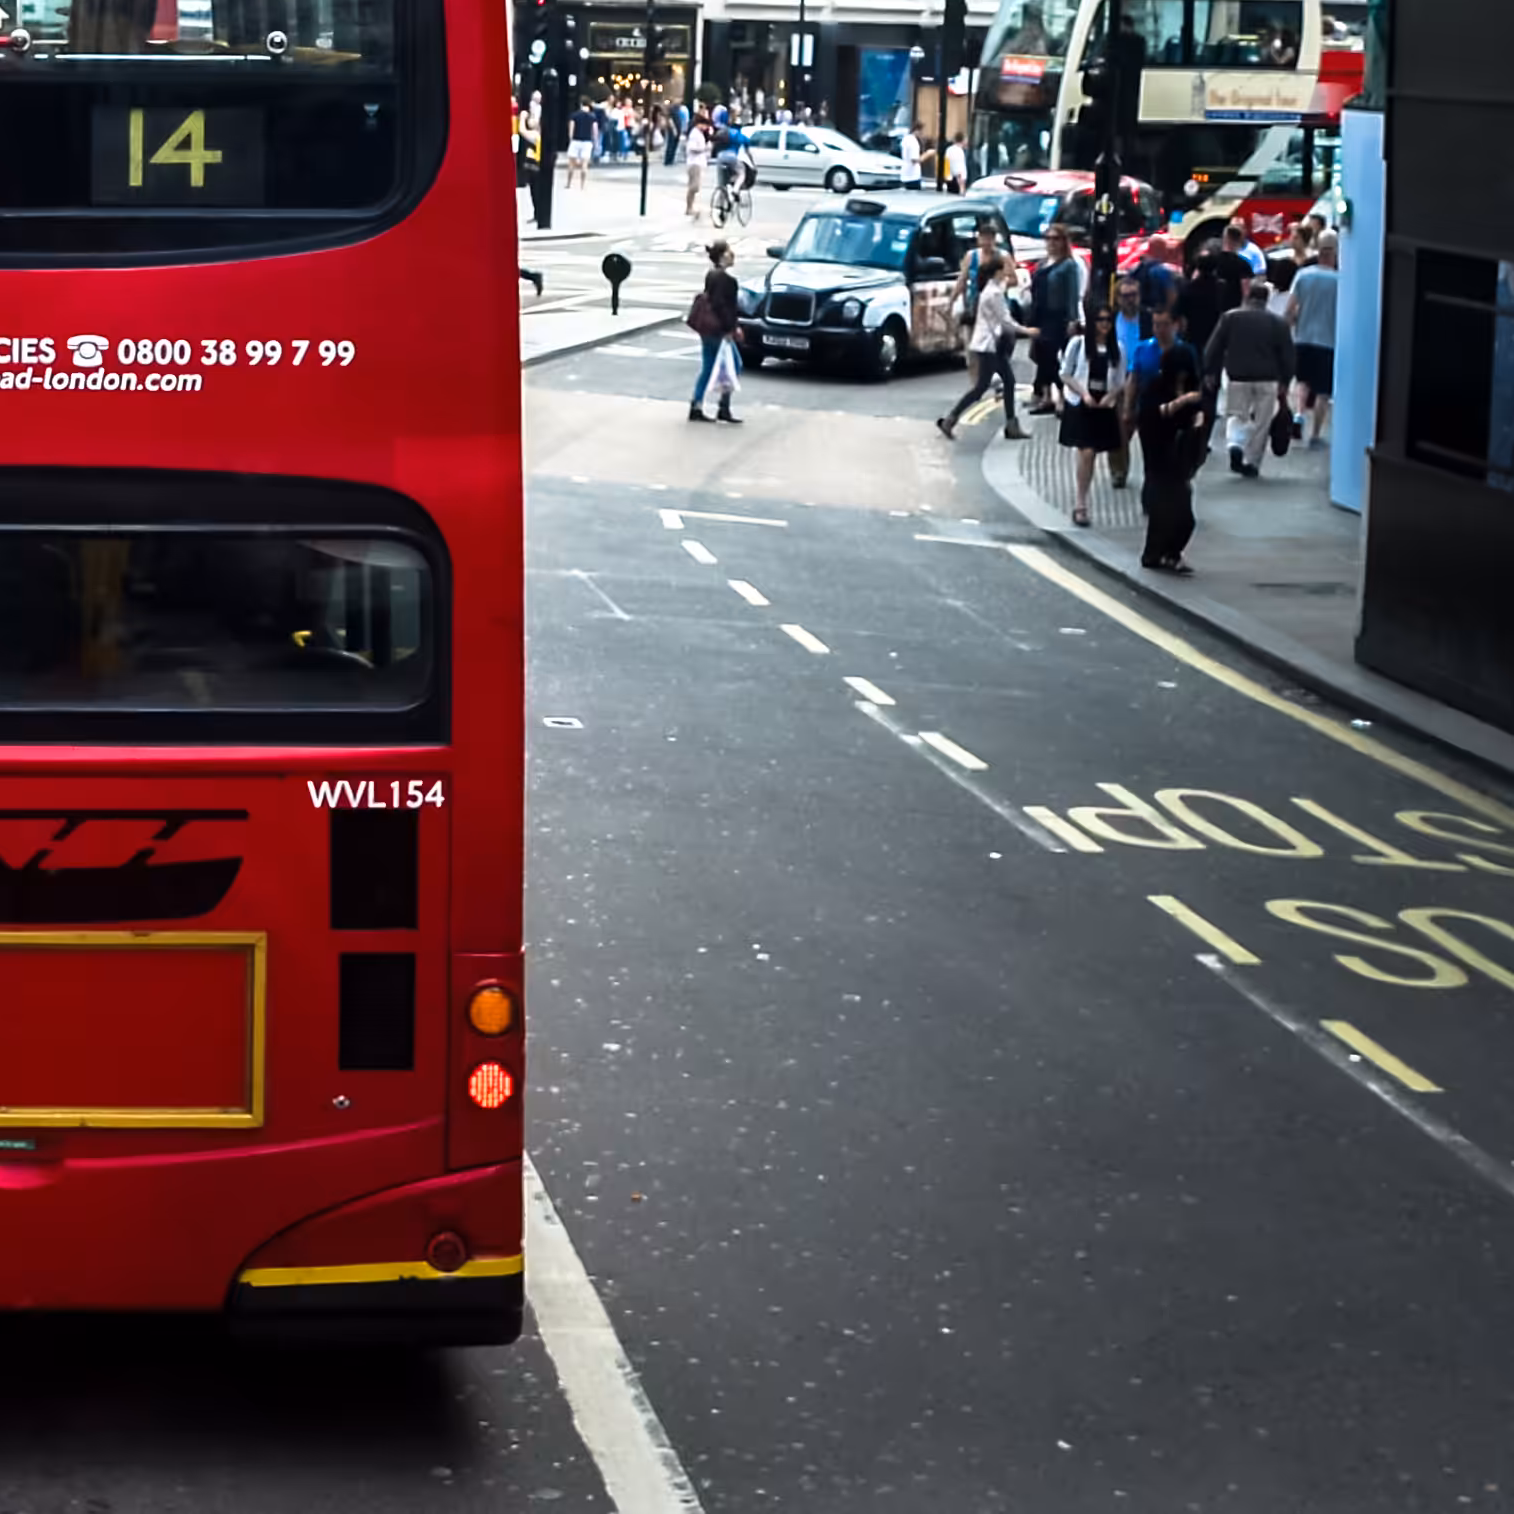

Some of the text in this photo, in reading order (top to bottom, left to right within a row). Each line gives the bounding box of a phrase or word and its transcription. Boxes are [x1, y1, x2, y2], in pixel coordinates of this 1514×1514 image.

[129, 108, 223, 187] 14
[117, 338, 192, 366] 0800
[200, 339, 237, 366] 38
[245, 339, 283, 366] 99
[291, 339, 311, 367] 7
[318, 339, 356, 367] 99
[306, 780, 446, 809] WVL154
